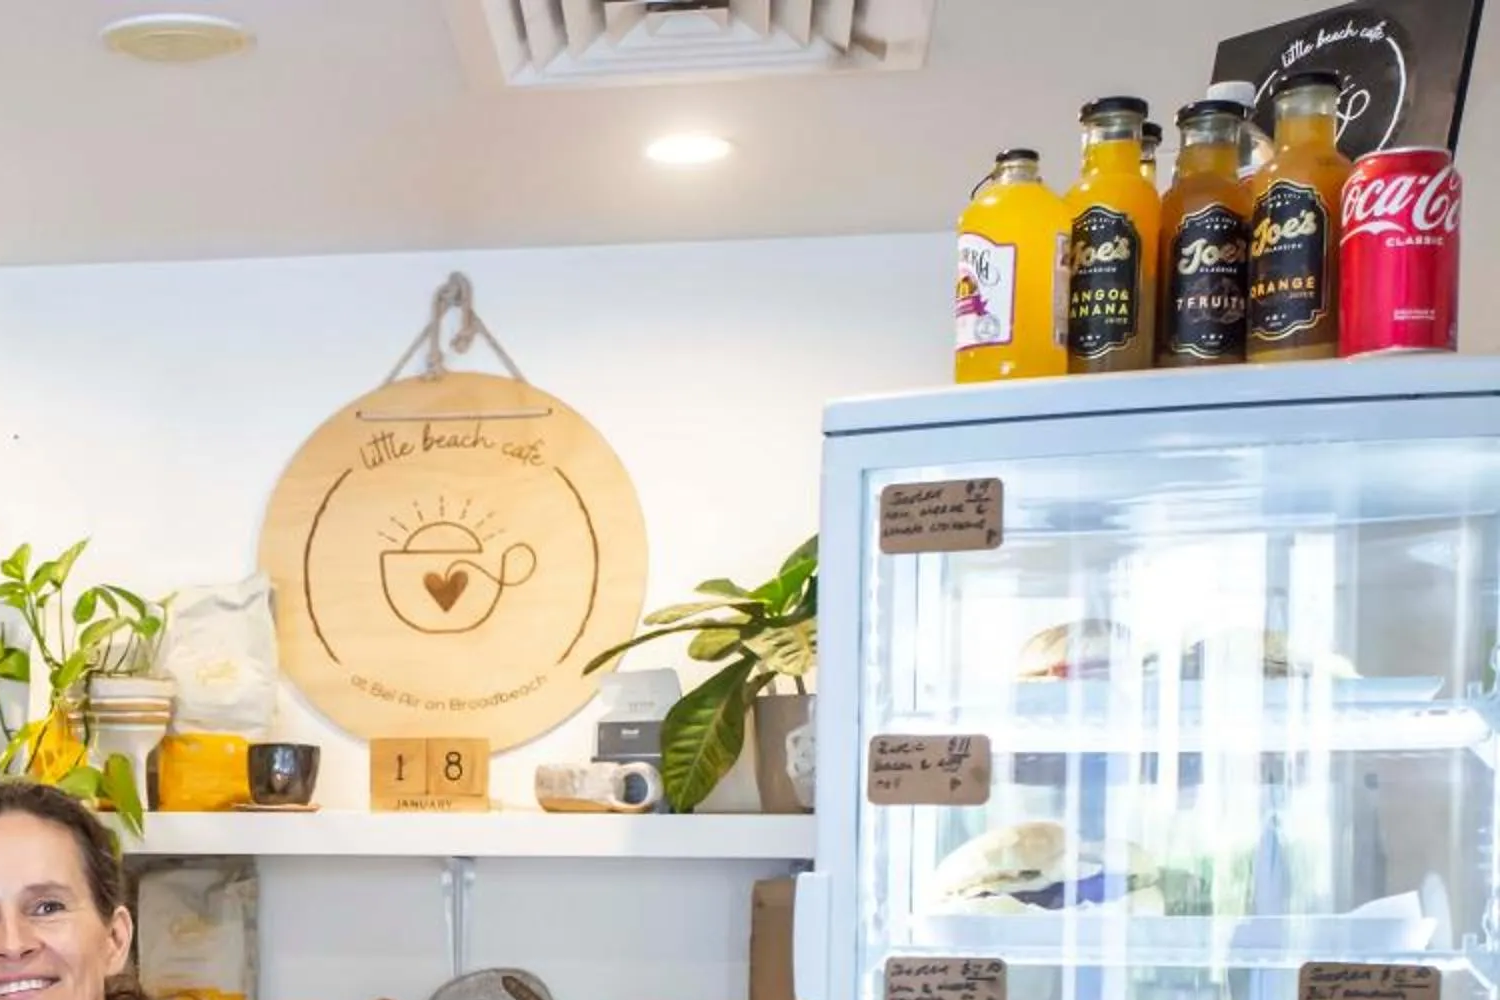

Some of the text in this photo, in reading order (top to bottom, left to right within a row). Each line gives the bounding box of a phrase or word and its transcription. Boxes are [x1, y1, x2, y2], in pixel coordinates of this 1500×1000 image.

[421, 422, 496, 452] beach
[444, 751, 463, 781] 8
[397, 799, 453, 811] JANUARY
